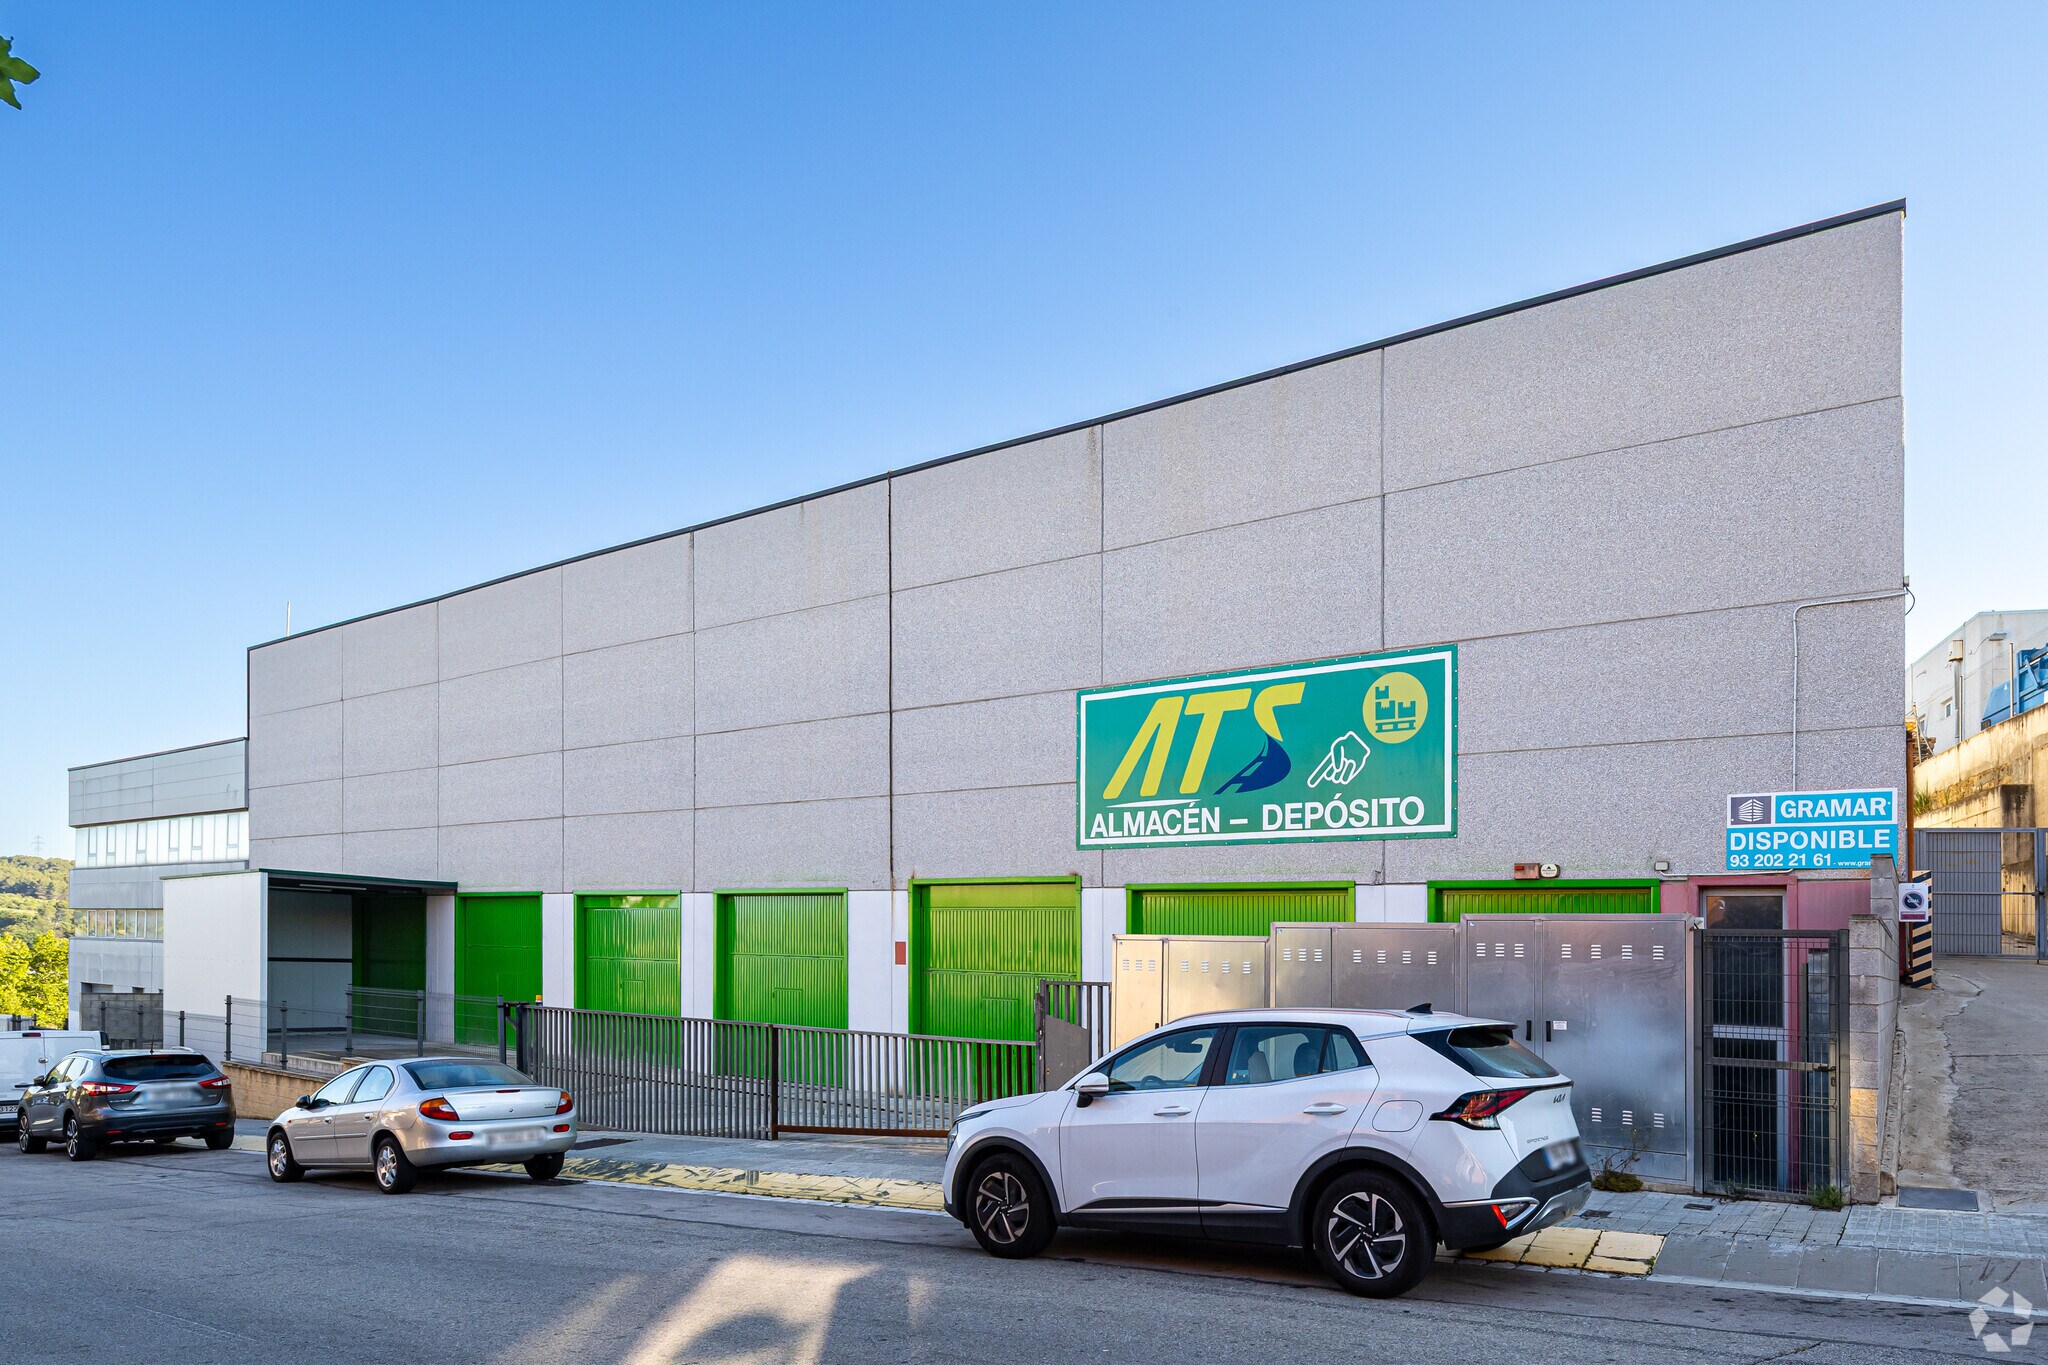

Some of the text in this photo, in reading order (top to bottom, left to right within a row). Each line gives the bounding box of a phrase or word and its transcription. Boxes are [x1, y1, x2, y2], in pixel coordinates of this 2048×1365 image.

[1103, 682, 1306, 800] ATS
[1089, 802, 1221, 838] ALMACÉN
[1262, 793, 1425, 831] DEPÓSITO
[1780, 797, 1887, 819] GRAMAR
[1729, 829, 1891, 851] DISPONIBLE
[1729, 854, 1749, 868] 93
[1754, 853, 1784, 868] 202
[1788, 853, 1807, 867] 21
[1813, 853, 1832, 867] 61
